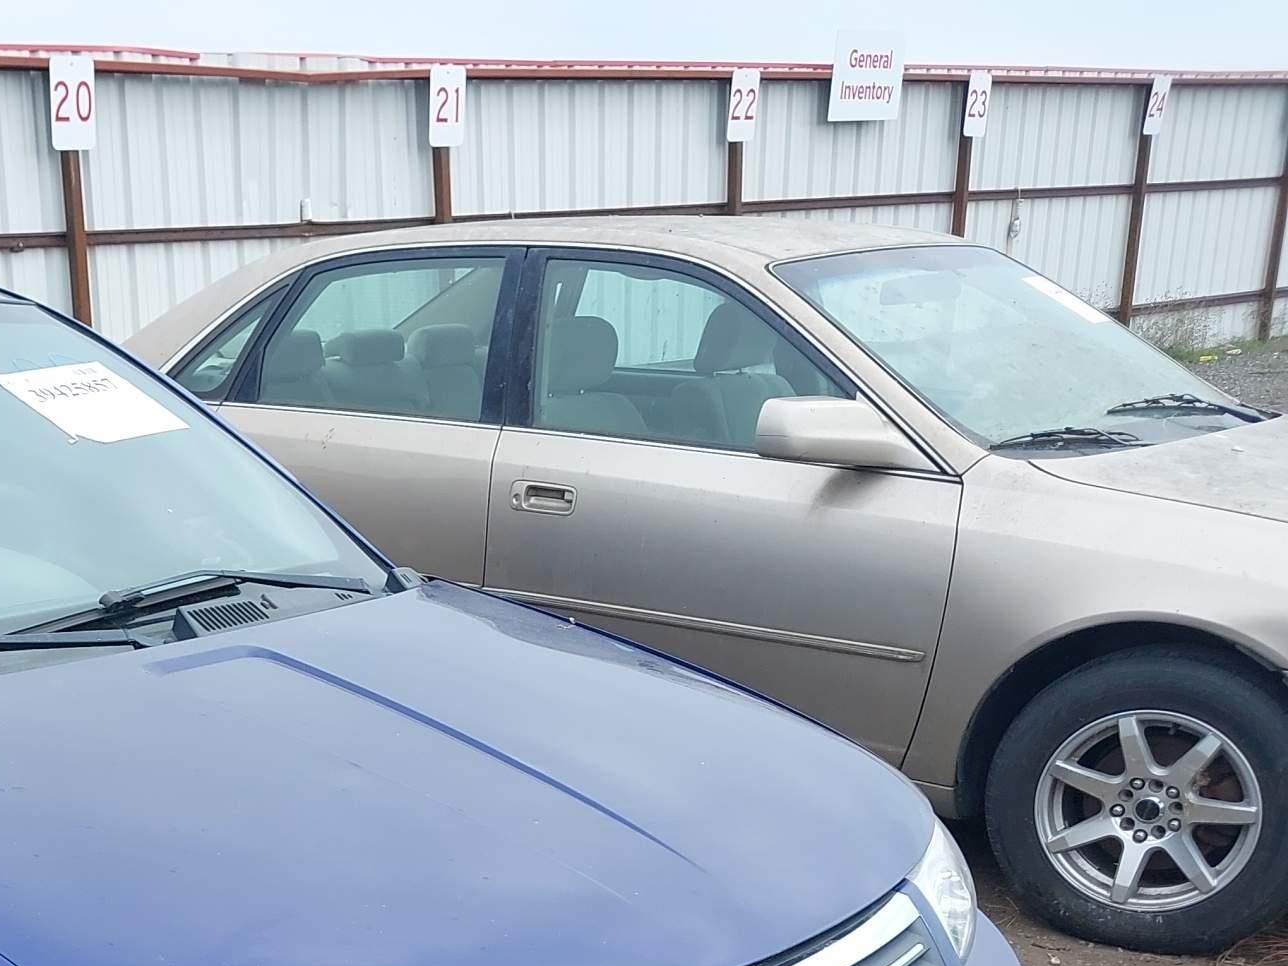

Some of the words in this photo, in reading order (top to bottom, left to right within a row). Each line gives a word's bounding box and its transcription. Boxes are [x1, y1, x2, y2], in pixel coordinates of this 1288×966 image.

[849, 48, 894, 69] General
[53, 79, 94, 124] 20
[436, 86, 460, 123] 21
[731, 88, 756, 121] 22
[839, 80, 894, 104] Inventory
[968, 89, 988, 118] 23
[1148, 91, 1167, 118] 24
[27, 377, 119, 403] 39425857
